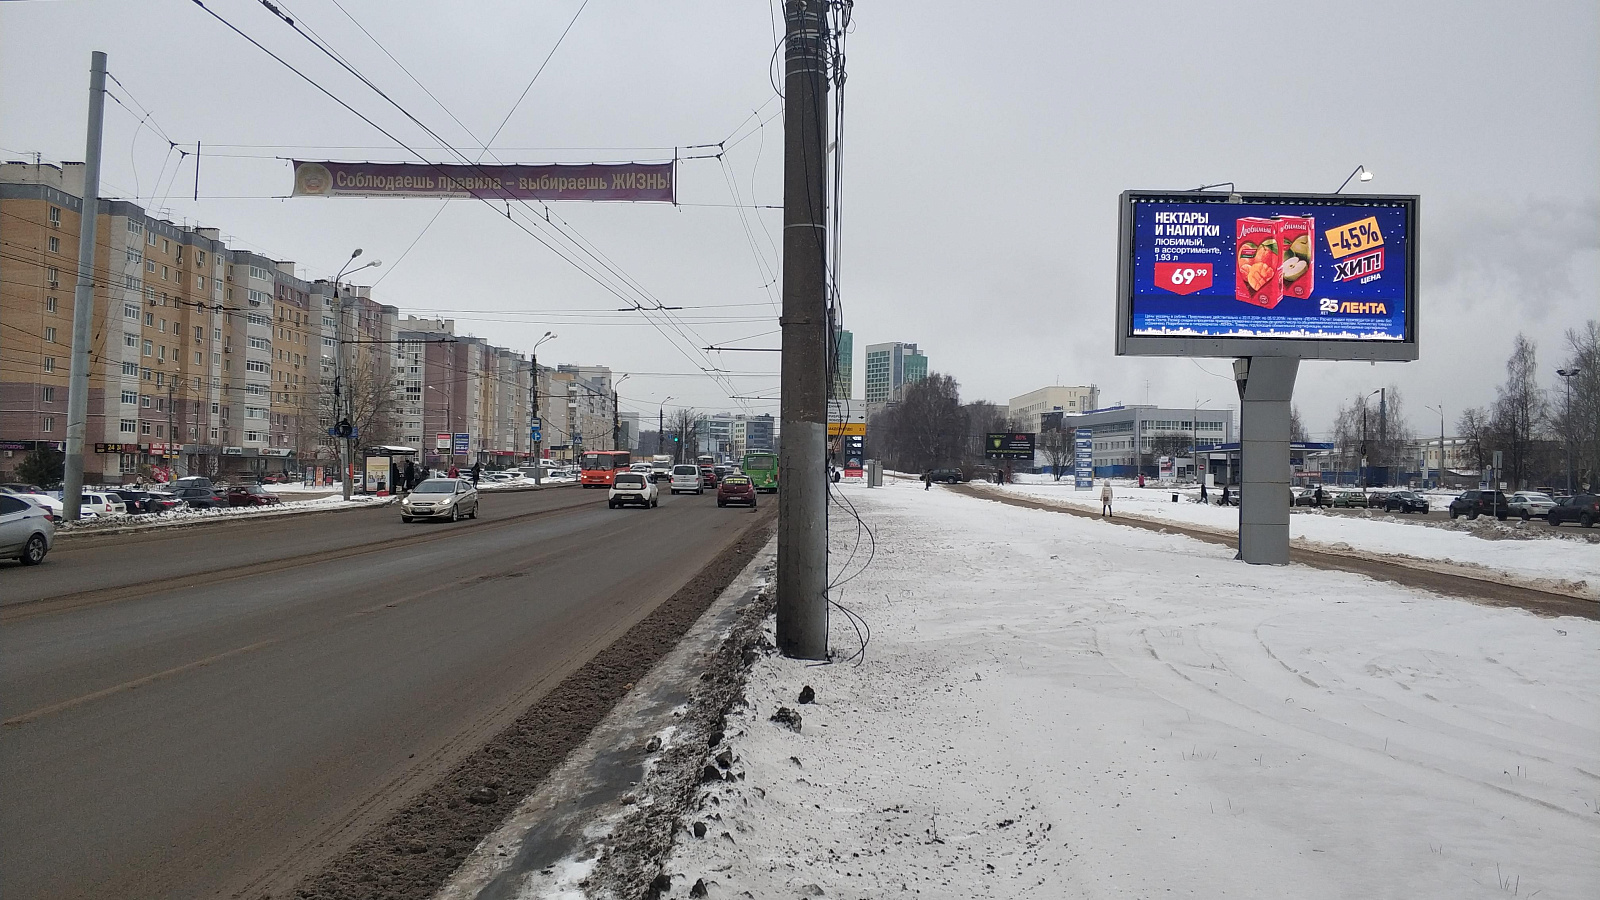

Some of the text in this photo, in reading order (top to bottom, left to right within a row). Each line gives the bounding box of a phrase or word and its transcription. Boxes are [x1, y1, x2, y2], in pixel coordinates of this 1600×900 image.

[336, 171, 434, 190] Соблюдаешь
[438, 176, 502, 190] правила
[518, 174, 608, 192] выбираешь
[612, 172, 670, 190] ЖИЗНЬ!
[1156, 212, 1208, 224] НЕКТАРЫ
[1155, 224, 1220, 236] И НАПИТКИ
[1154, 237, 1205, 247] ЛЮБИМЫЙ,
[1332, 222, 1380, 251] -45%
[1162, 247, 1222, 255] ассортименте,
[1333, 252, 1382, 282] ХИТ!
[1360, 273, 1382, 284] ЦЕНА
[1320, 298, 1338, 312] 25
[1340, 302, 1387, 314] ЛЕНТА
